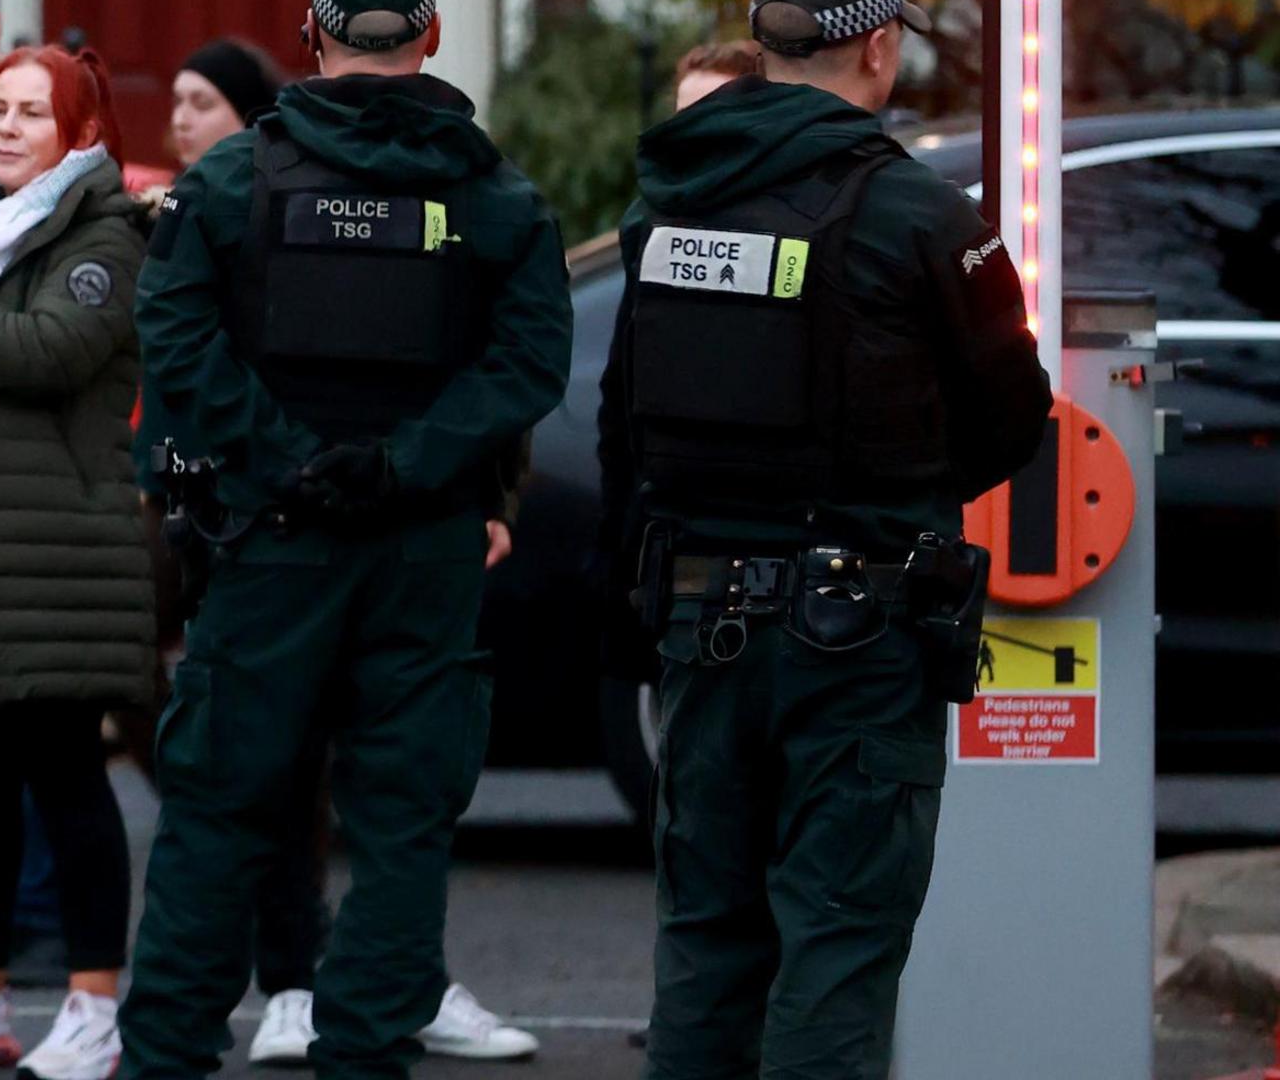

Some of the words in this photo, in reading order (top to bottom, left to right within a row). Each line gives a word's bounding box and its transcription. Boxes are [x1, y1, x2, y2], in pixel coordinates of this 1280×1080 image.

[316, 198, 389, 218] POLICE
[332, 221, 372, 239] TSG
[670, 237, 741, 260] POLICE
[669, 261, 707, 282] TSG
[984, 697, 1071, 712] Pedestrians
[979, 713, 1026, 729] please
[1029, 714, 1048, 728] do
[1052, 714, 1076, 728] not
[987, 729, 1020, 743] walk
[1024, 729, 1067, 743] under
[1002, 743, 1052, 758] barrier
